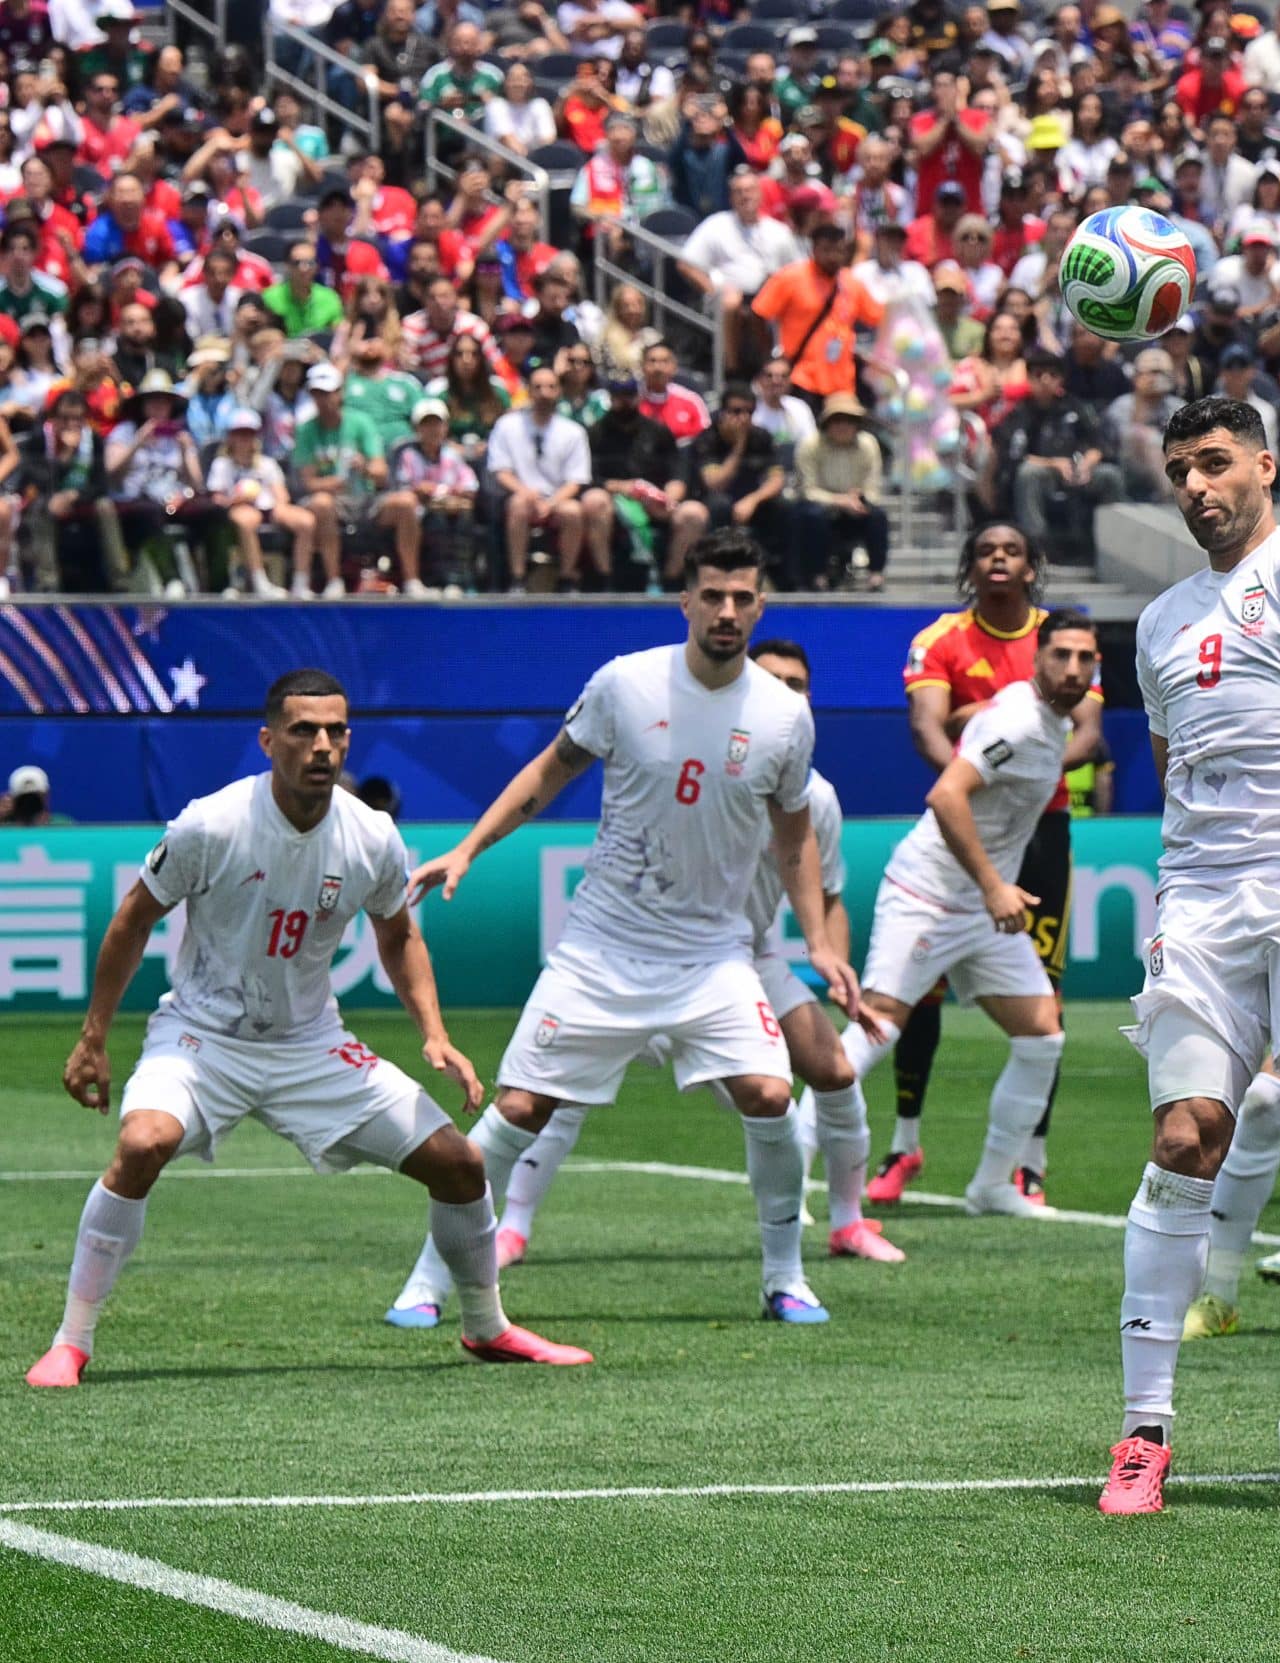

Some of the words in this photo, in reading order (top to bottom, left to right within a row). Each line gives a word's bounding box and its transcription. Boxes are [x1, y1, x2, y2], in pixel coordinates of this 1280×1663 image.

[1198, 633, 1222, 688] 9
[675, 758, 706, 805] 6
[267, 908, 309, 959] 19
